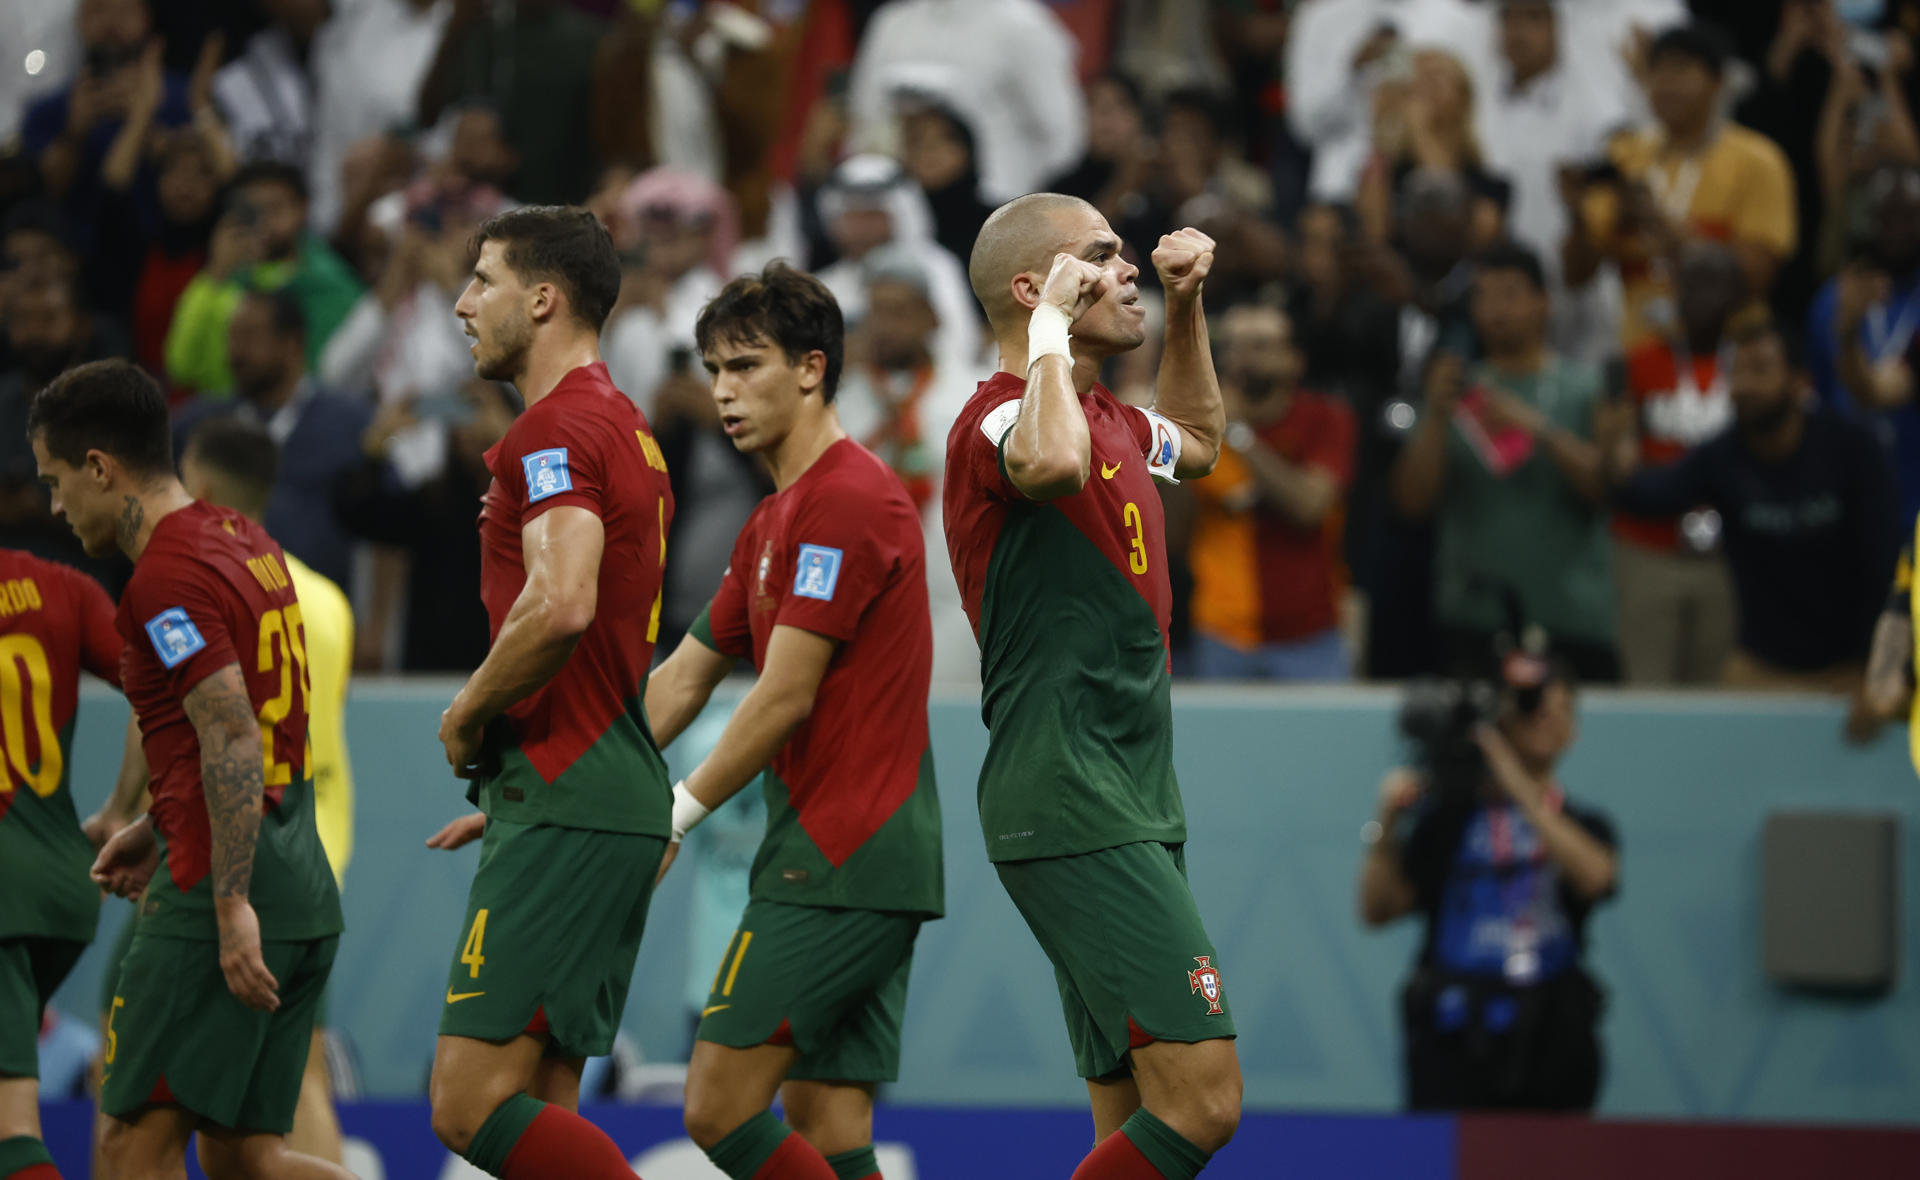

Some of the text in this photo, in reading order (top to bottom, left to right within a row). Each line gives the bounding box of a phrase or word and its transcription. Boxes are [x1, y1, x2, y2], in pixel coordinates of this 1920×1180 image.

[1124, 502, 1148, 575] 3
[461, 908, 489, 978] 4
[710, 929, 753, 997] 11
